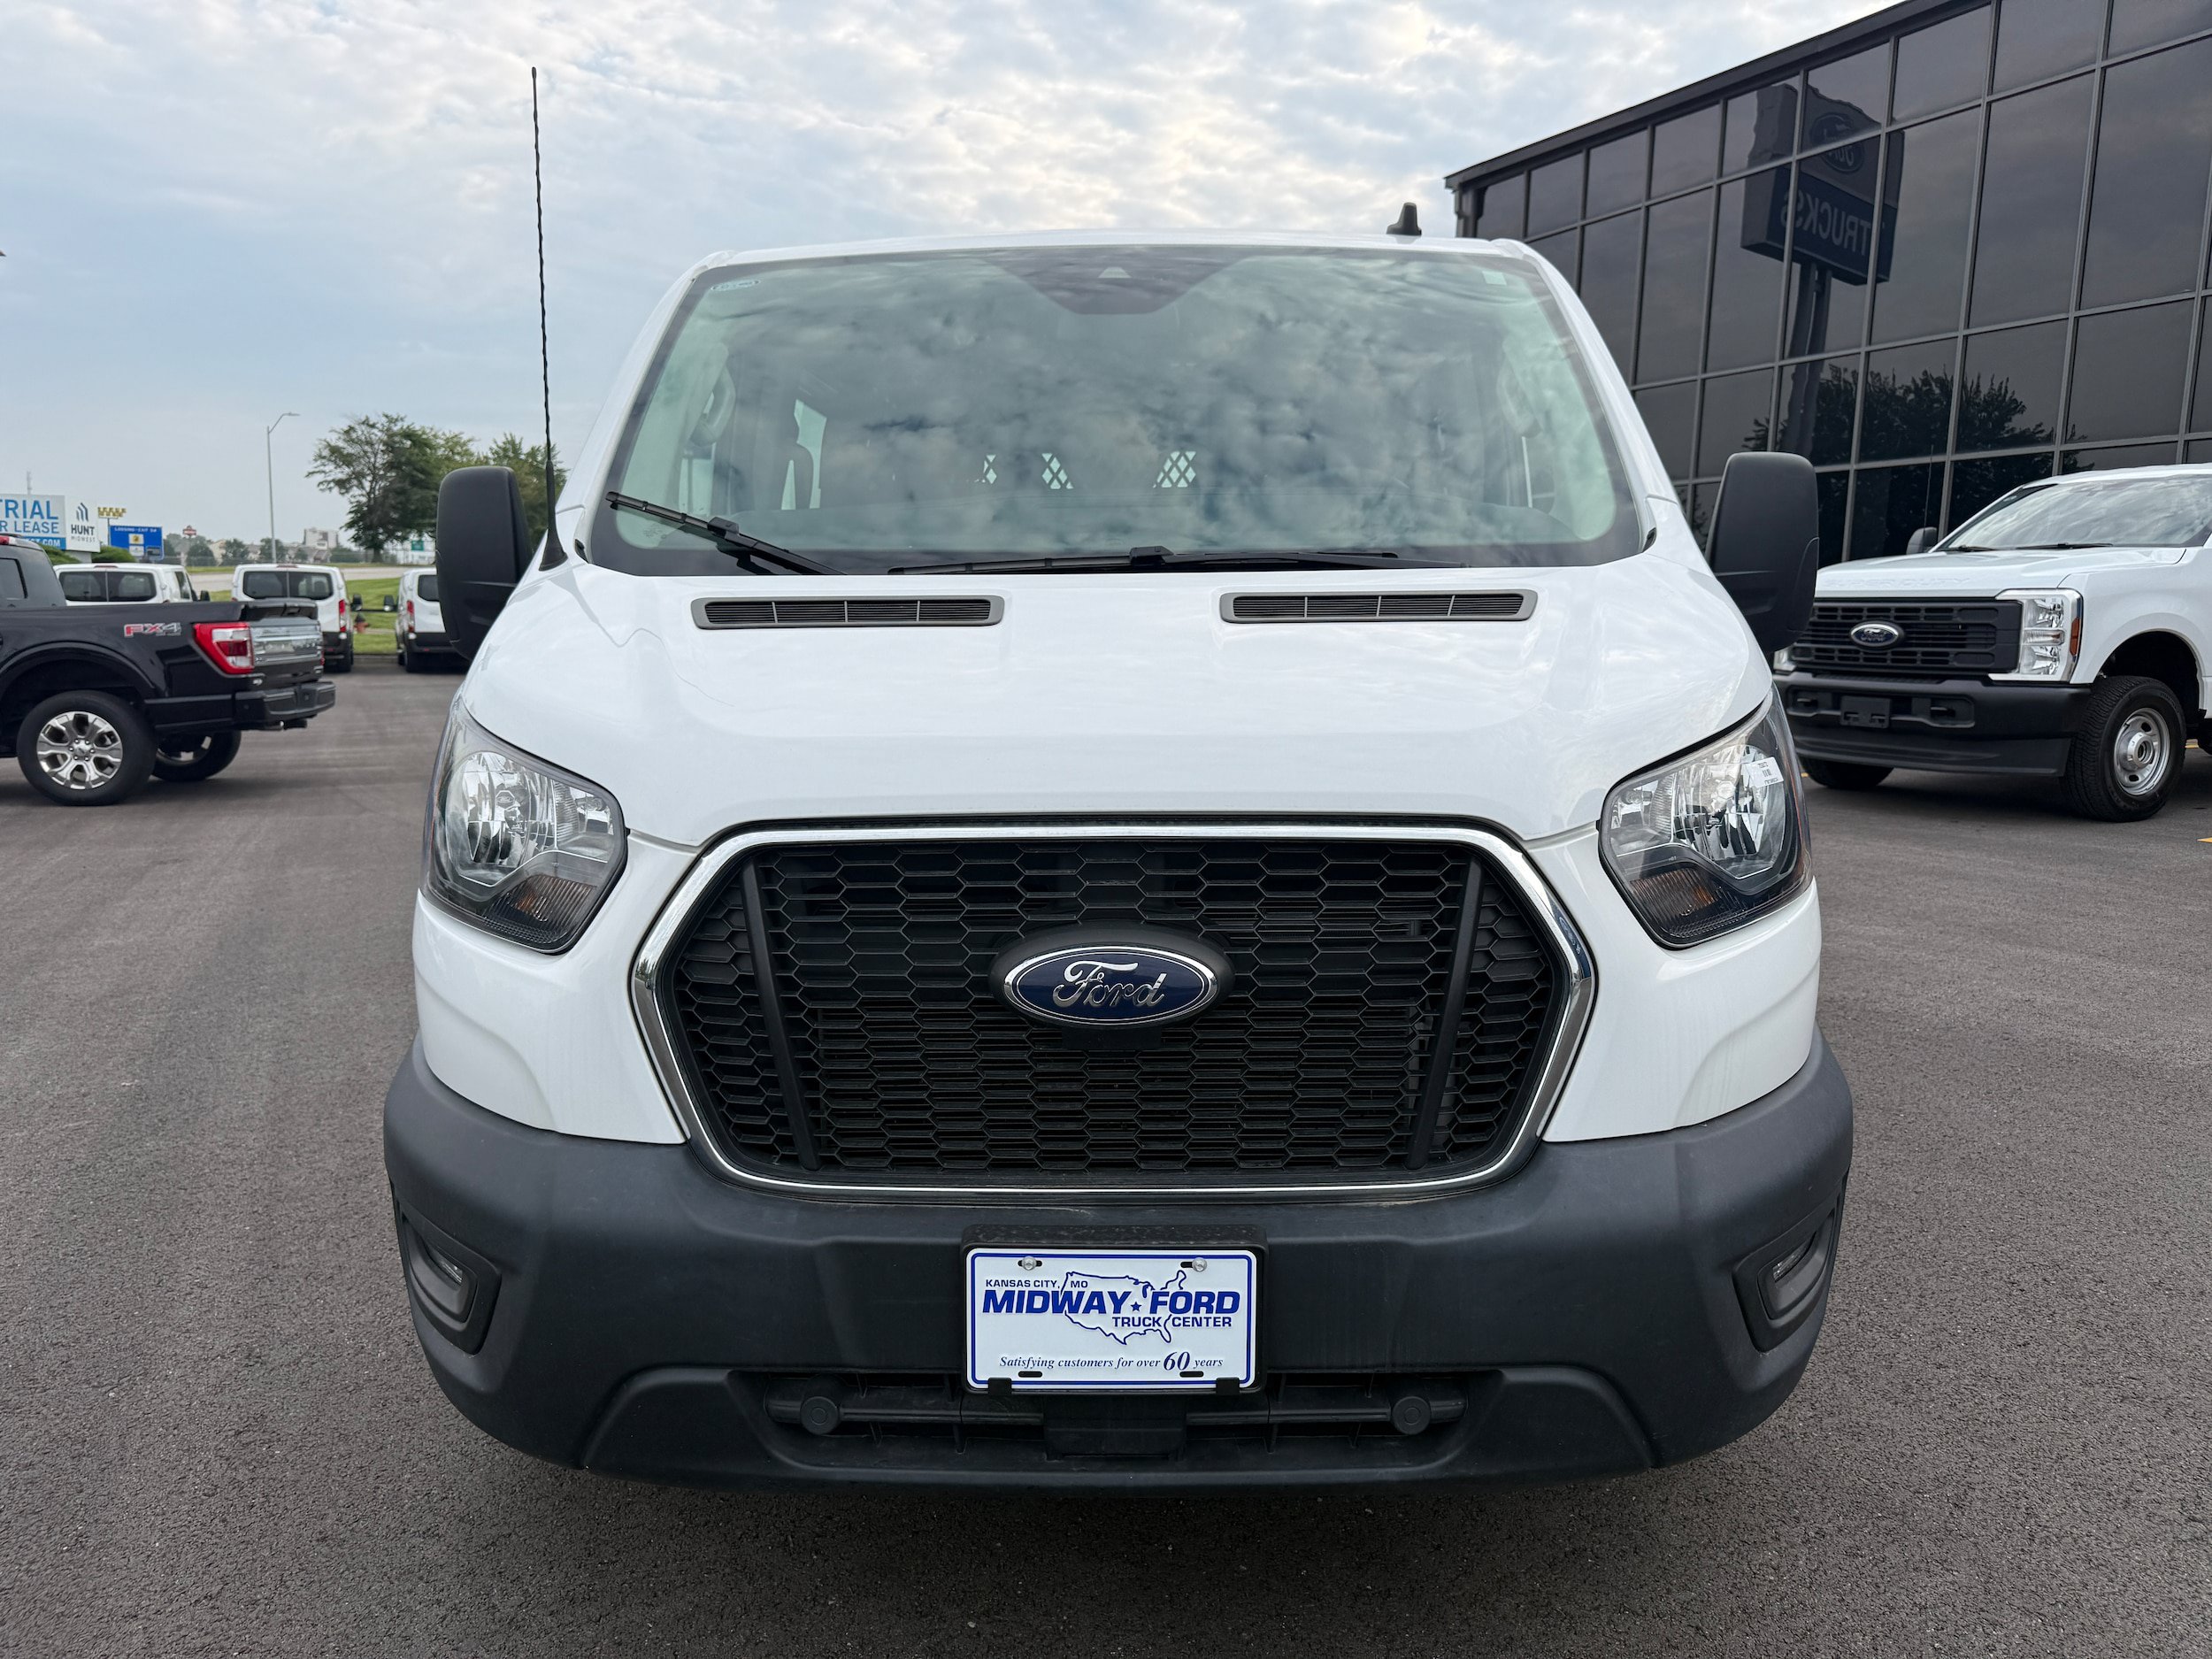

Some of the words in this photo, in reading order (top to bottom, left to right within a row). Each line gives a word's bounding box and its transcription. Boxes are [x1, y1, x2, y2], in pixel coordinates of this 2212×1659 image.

[0, 499, 58, 520] RIAL
[14, 521, 60, 534] LEASE
[71, 524, 95, 536] HUNT
[124, 623, 181, 637] FX4
[1052, 960, 1167, 1008] Ford
[1033, 1279, 1060, 1289] CITY,
[982, 1290, 1132, 1314] MIDWAY
[1149, 1291, 1240, 1315] FORD
[1112, 1317, 1162, 1327] TRUCK
[1171, 1317, 1232, 1327] CENTER
[1000, 1356, 1055, 1370] Satisfying
[1058, 1358, 1113, 1368] customers
[1114, 1356, 1134, 1370] for
[1164, 1351, 1191, 1371] 60
[1194, 1359, 1224, 1371] years
